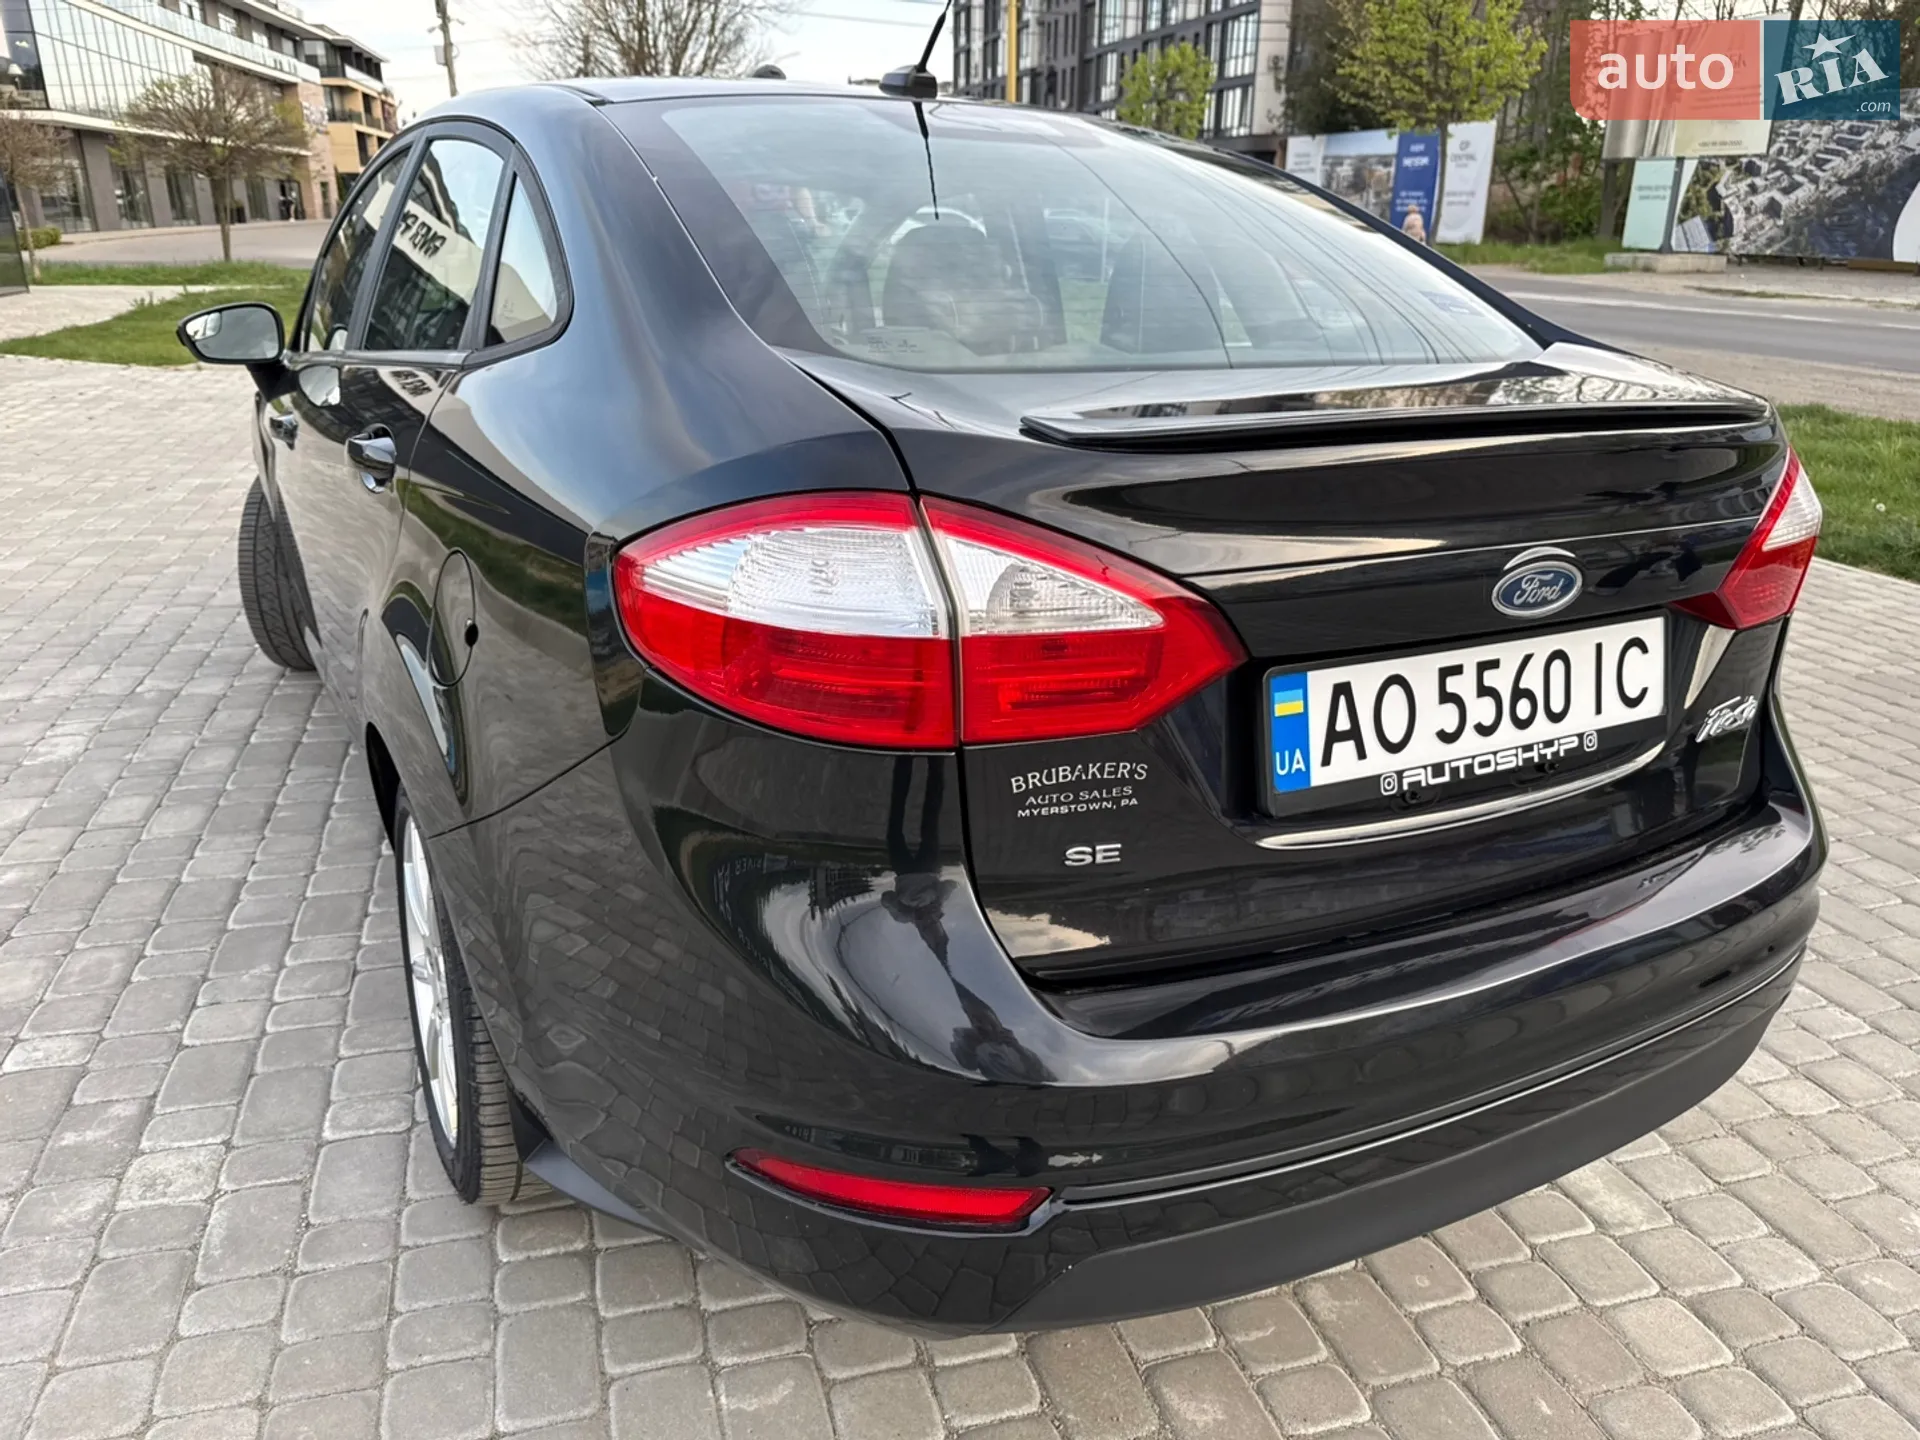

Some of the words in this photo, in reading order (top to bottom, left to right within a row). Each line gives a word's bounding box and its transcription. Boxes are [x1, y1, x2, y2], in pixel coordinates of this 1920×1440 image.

[1513, 573, 1564, 606] Ford
[1320, 674, 1417, 768] AO
[1435, 649, 1572, 745] 5560
[1594, 636, 1650, 716] IC
[1276, 749, 1306, 776] UA
[1402, 735, 1579, 790] AUTOSHYP
[1011, 762, 1148, 794] BRUBAKER'S
[1017, 801, 1117, 818] MYERSTOWN,
[1121, 797, 1139, 807] PA
[1025, 792, 1074, 806] AUTO
[1079, 785, 1133, 801] SALES
[1064, 843, 1122, 867] SE
